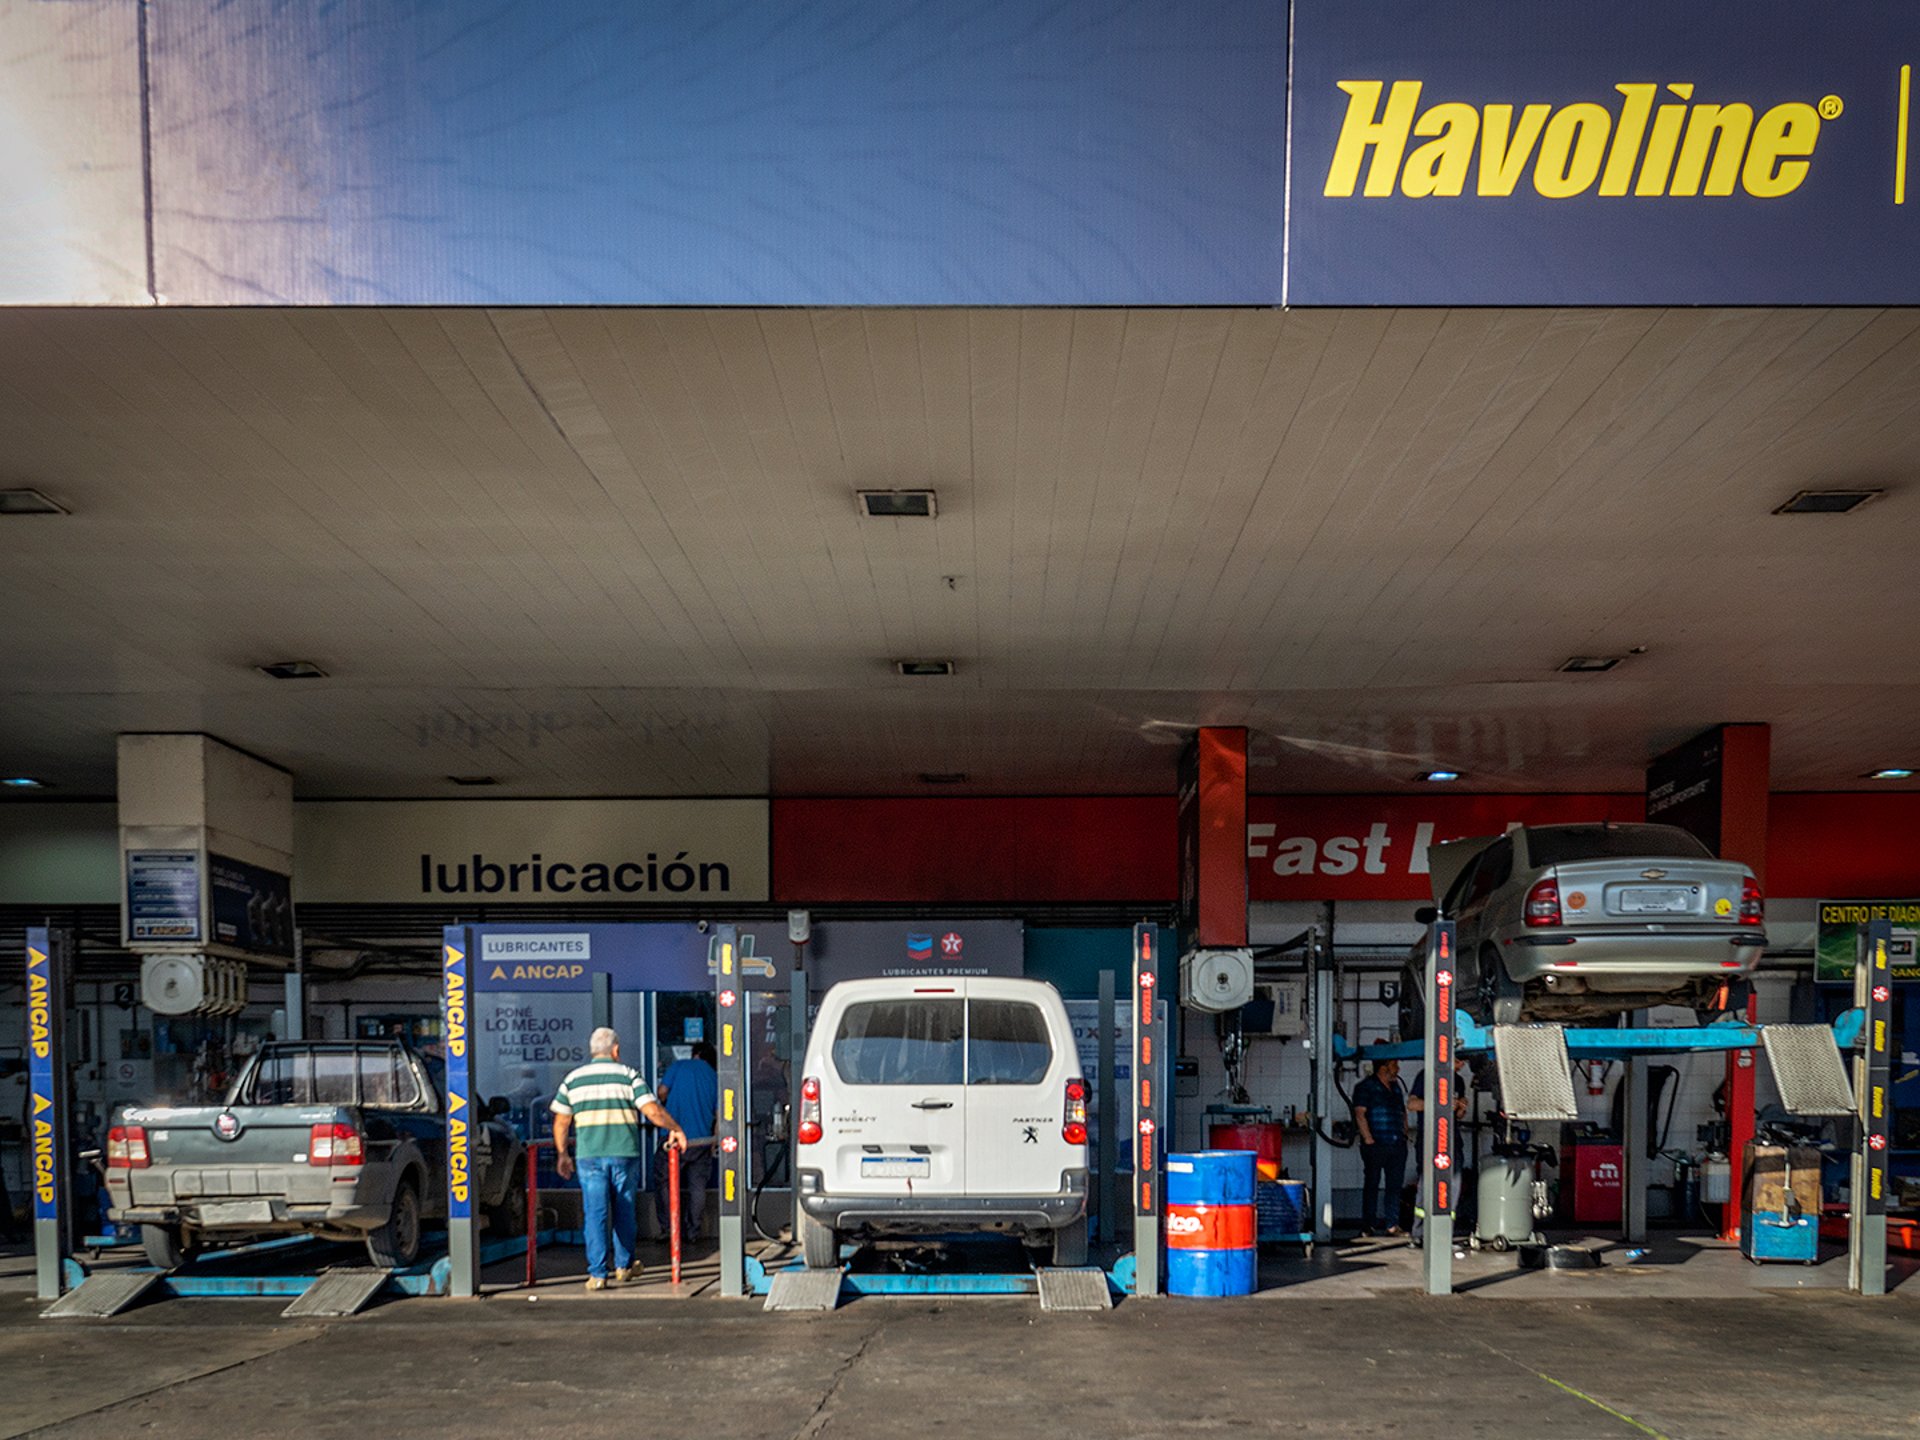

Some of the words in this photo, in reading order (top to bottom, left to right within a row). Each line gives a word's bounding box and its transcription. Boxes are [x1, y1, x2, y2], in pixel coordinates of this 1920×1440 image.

[1248, 822, 1392, 875] Fast
[421, 852, 730, 893] lubricación
[1823, 906, 1869, 923] CENTRO
[488, 941, 584, 953] LUBRICANTES
[513, 965, 584, 979] ANCAP
[882, 967, 944, 976] LUBRICANTES
[947, 967, 989, 975] PREMIUM
[119, 986, 129, 1000] 2
[1384, 983, 1395, 999] 5
[29, 973, 49, 1058] ANCAP
[447, 972, 465, 1057] ANCAP
[495, 1006, 533, 1018] PONÉ
[485, 1019, 508, 1031] LO
[512, 1018, 574, 1031] MEJOR
[522, 1047, 584, 1061] LEJOS
[34, 1119, 54, 1204] ANCAP
[449, 1118, 468, 1203] ANCAP
